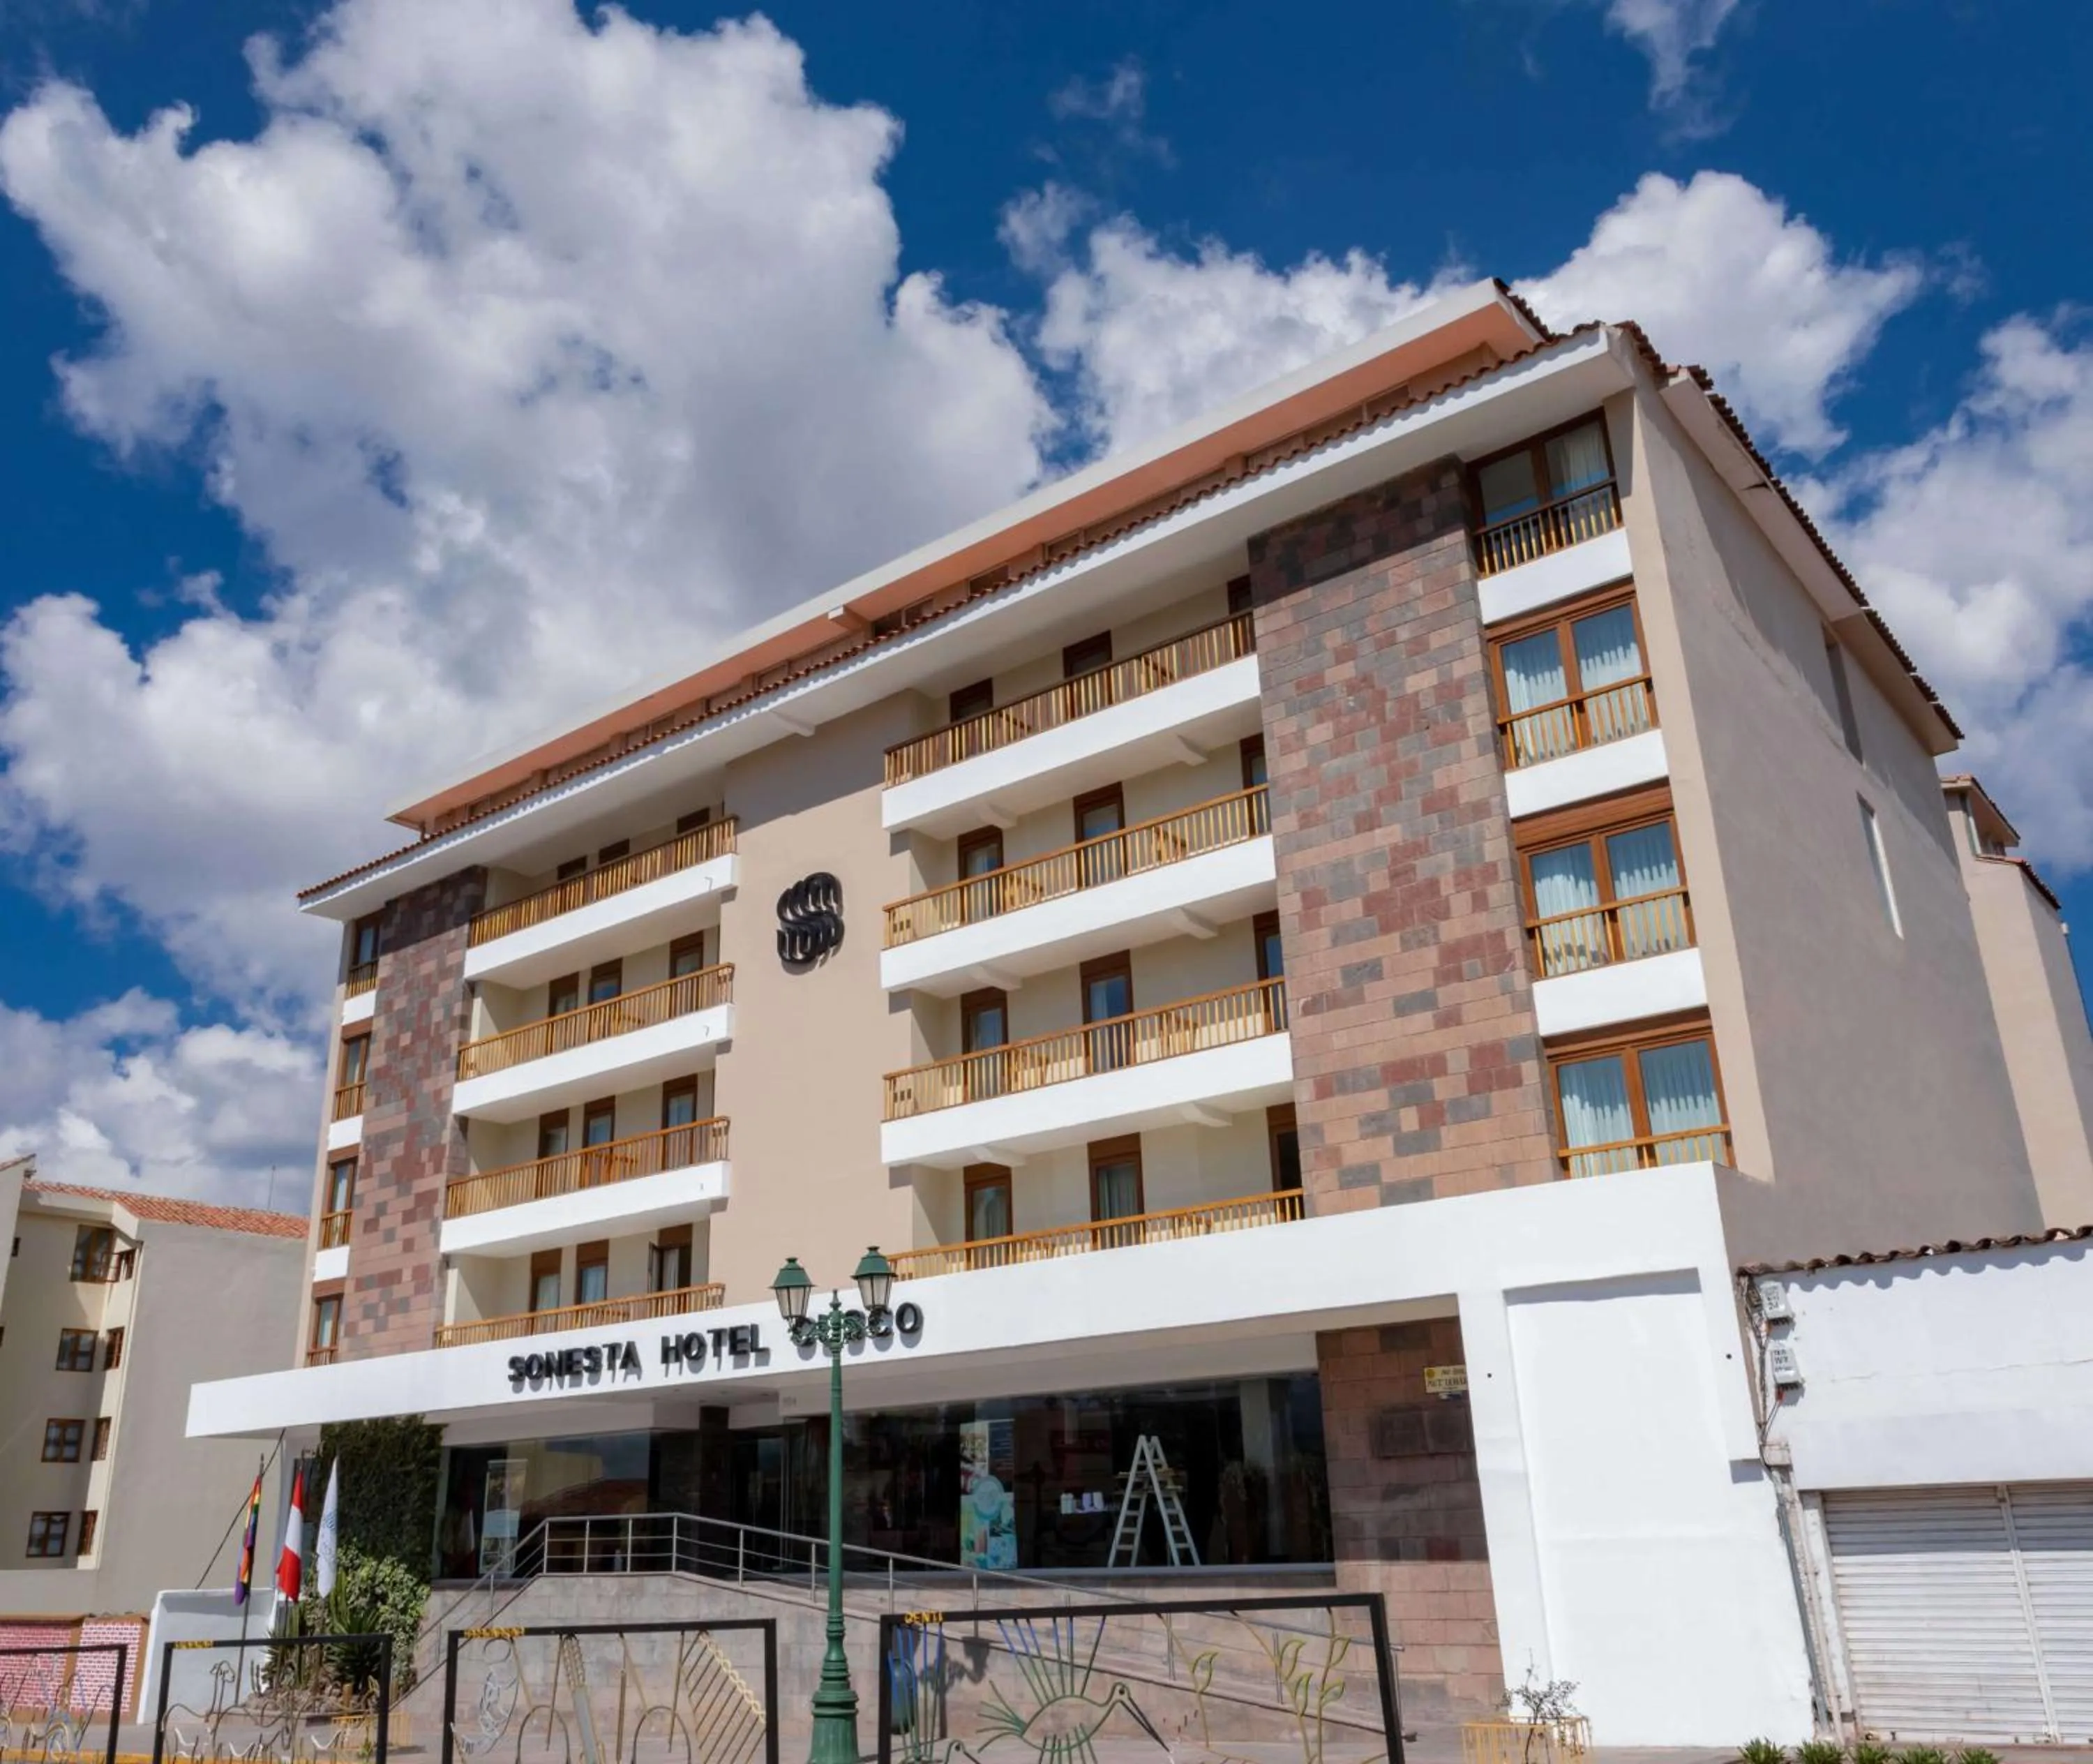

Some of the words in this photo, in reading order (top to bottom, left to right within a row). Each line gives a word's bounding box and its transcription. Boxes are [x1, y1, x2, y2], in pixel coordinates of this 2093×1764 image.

[508, 1340, 641, 1382] SONESTA
[661, 1323, 770, 1364] HOTEL
[791, 1301, 923, 1347] CCO
